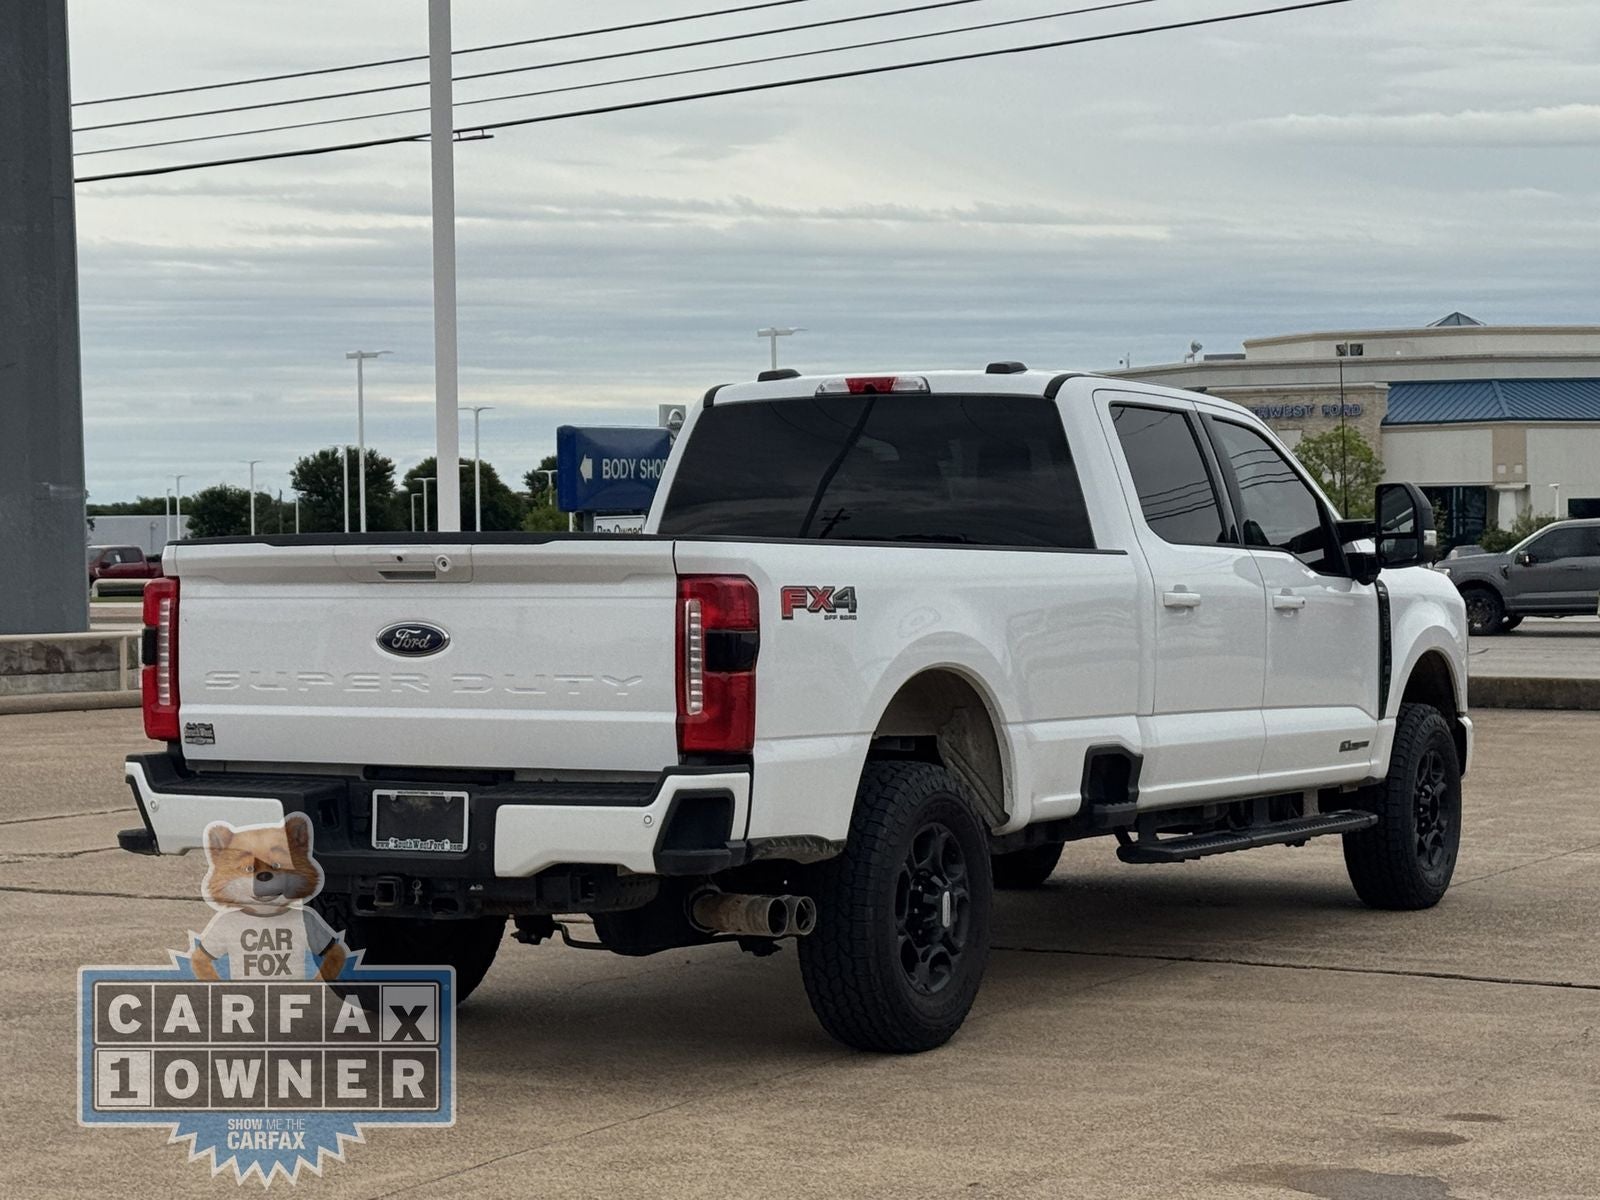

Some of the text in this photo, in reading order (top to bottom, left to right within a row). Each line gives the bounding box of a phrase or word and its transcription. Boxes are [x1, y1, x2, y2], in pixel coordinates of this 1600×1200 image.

[1321, 404, 1362, 416] FORD
[602, 458, 636, 479] BODY
[781, 586, 857, 620] FX4
[392, 628, 431, 649] Ford
[205, 670, 643, 696] SUPER DUTY
